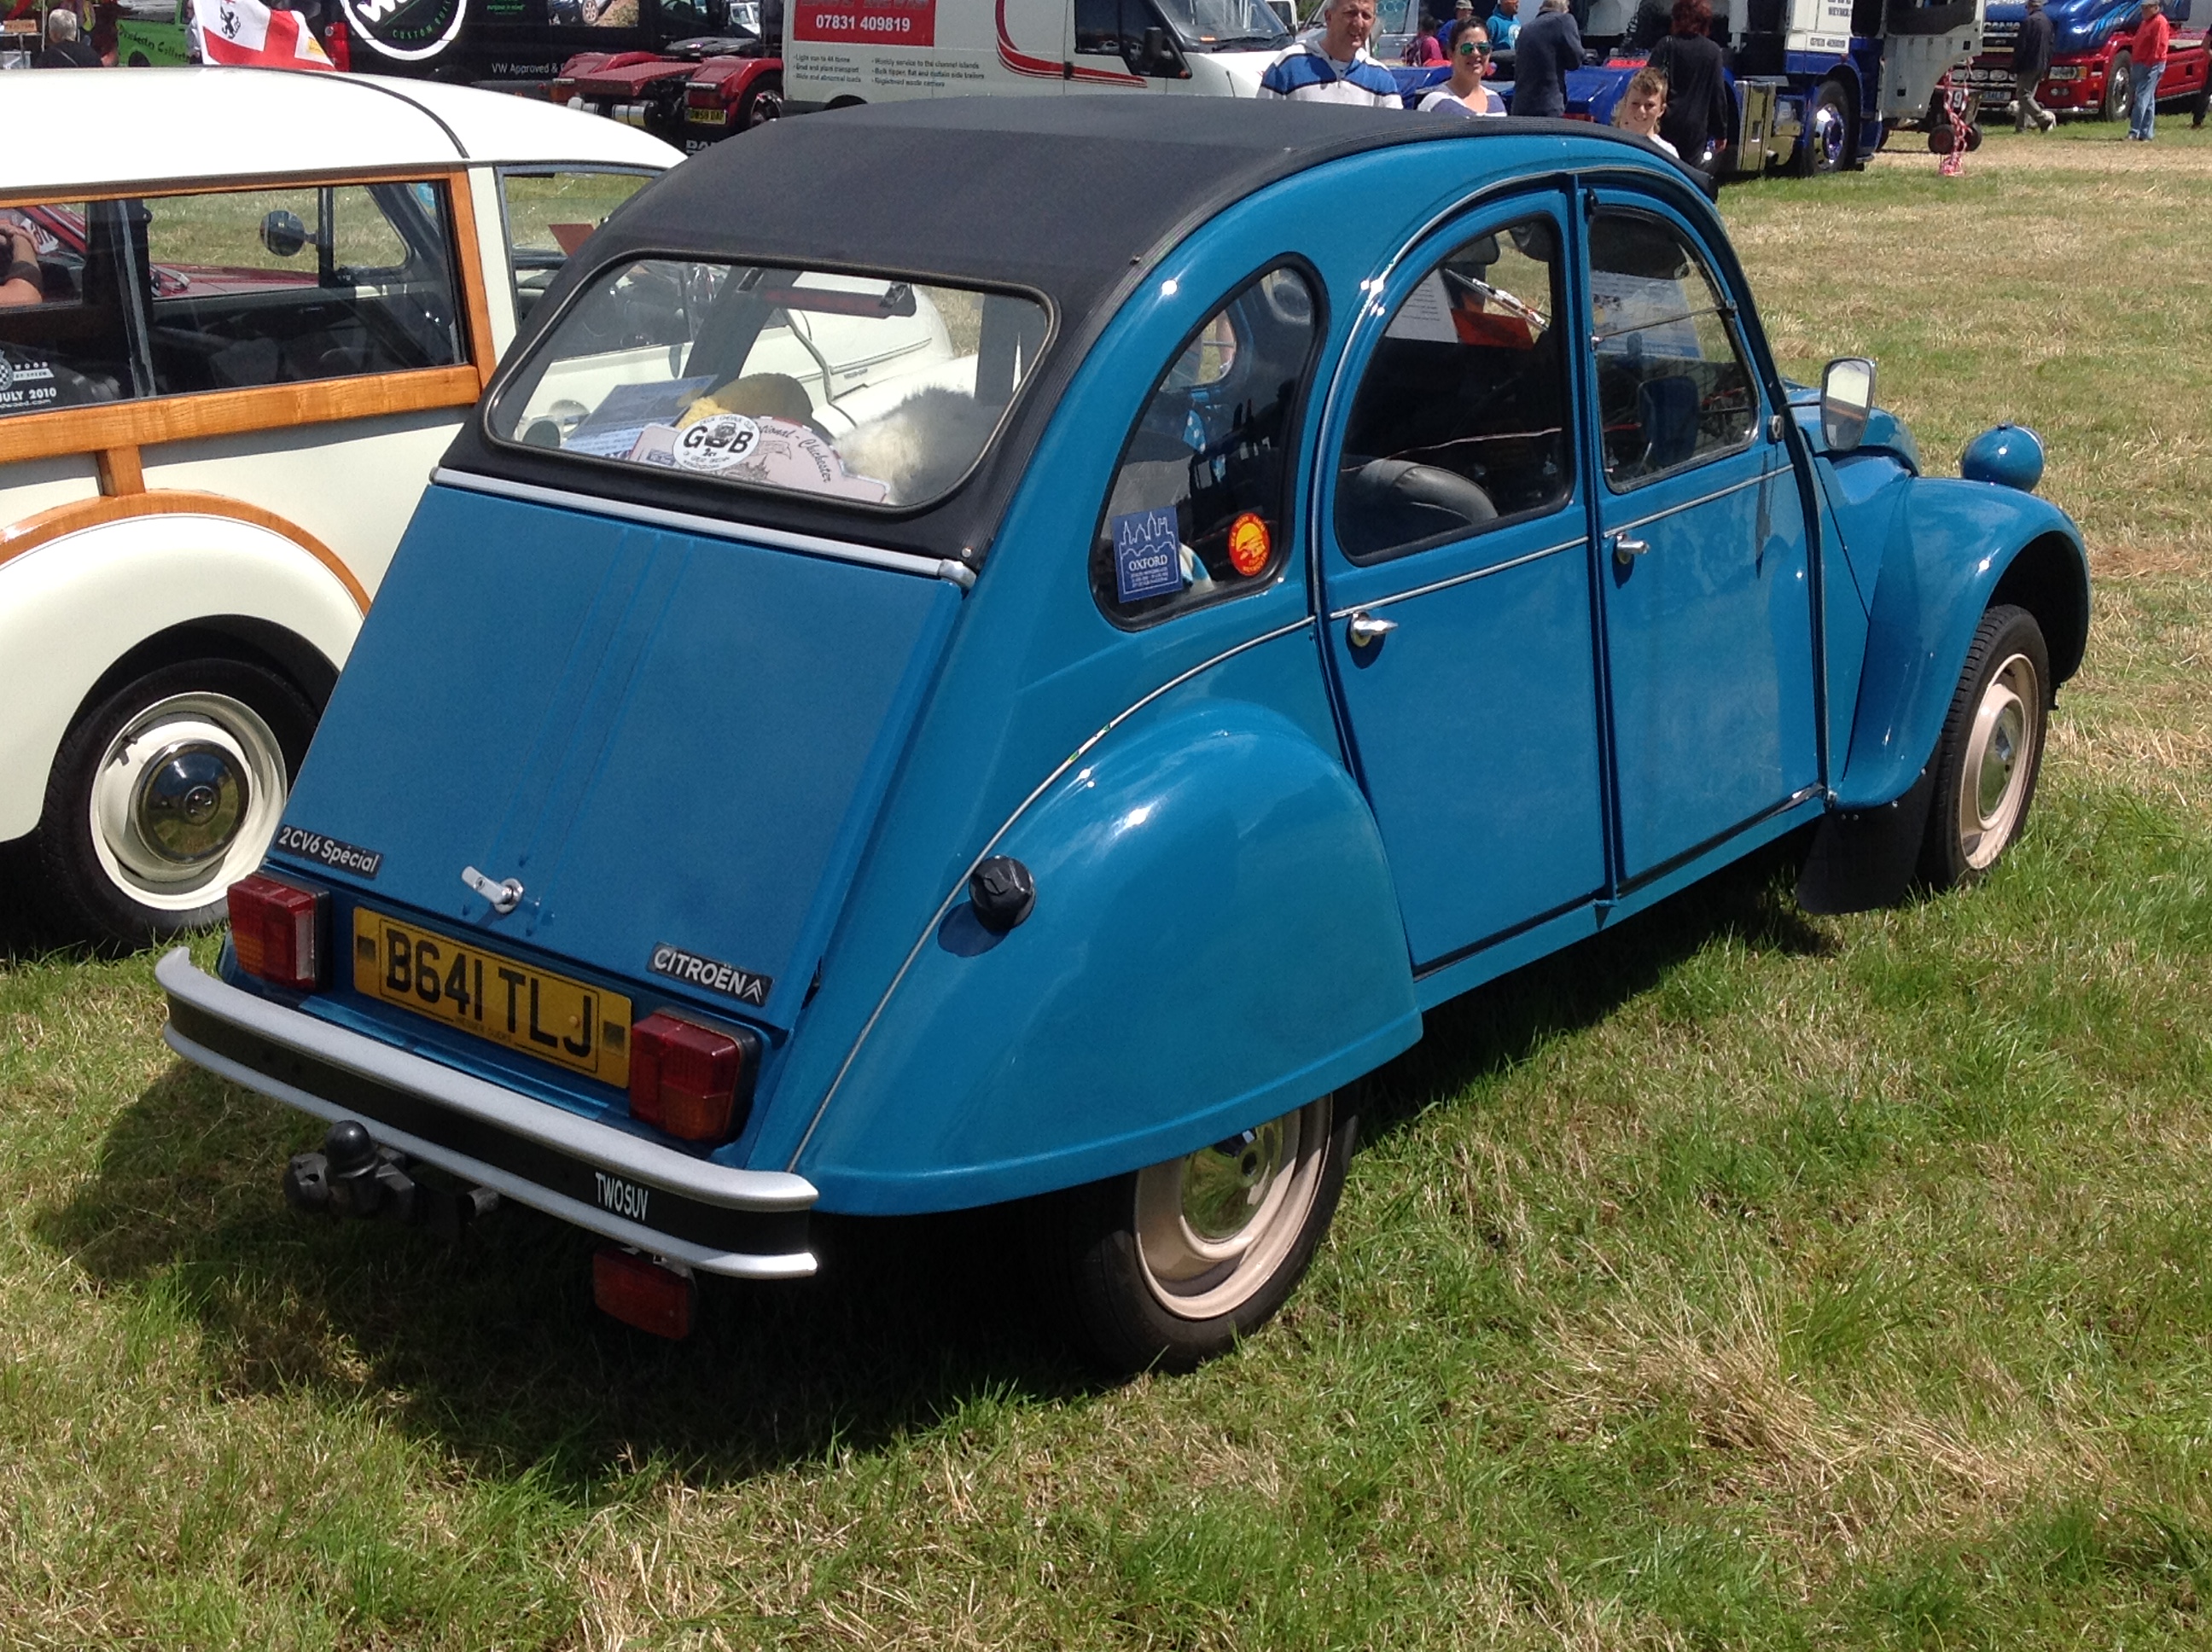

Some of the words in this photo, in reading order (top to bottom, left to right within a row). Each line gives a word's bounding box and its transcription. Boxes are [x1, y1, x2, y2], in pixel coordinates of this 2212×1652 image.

[816, 15, 855, 30] 07831
[859, 16, 911, 32] 409819
[492, 63, 507, 73] VW
[509, 62, 549, 75] Approved
[550, 62, 558, 73] &
[28, 387, 57, 399] 2010
[1129, 554, 1168, 572] OXFORD
[278, 826, 322, 853] 2CV6
[654, 948, 748, 995] CITROËN
[386, 928, 483, 1022] B641
[498, 966, 592, 1058] TLJ
[595, 1172, 649, 1221] TWOSUV
